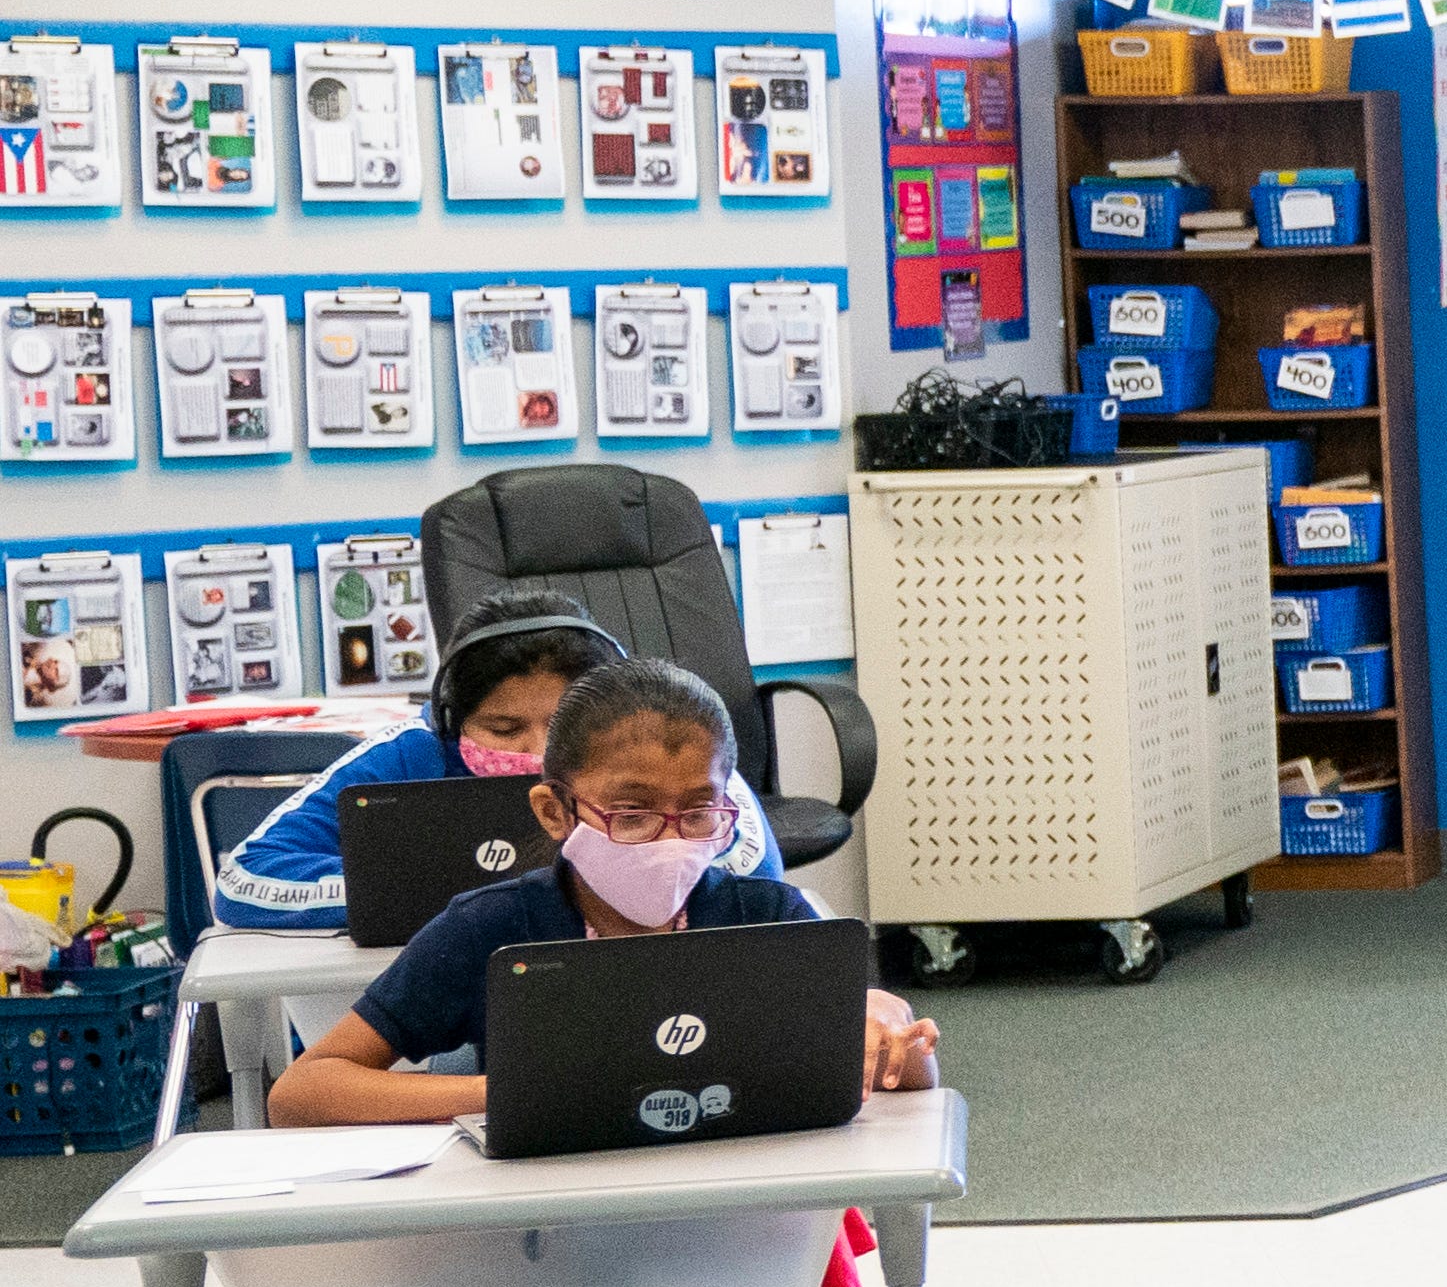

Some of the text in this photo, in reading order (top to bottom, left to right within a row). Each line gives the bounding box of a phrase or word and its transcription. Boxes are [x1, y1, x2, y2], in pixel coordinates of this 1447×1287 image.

[1096, 208, 1140, 231] 500
[1115, 305, 1159, 325] 600
[1112, 374, 1155, 395] 400
[1285, 365, 1328, 391] 400
[1304, 522, 1347, 540] 600
[1271, 610, 1302, 628] 00
[480, 838, 514, 872] hp
[233, 882, 255, 897] UP
[254, 885, 270, 900] IT
[270, 888, 310, 904] HYPE
[660, 1013, 705, 1056] hp
[644, 1096, 688, 1112] POTATO
[663, 1109, 691, 1128] BIG
